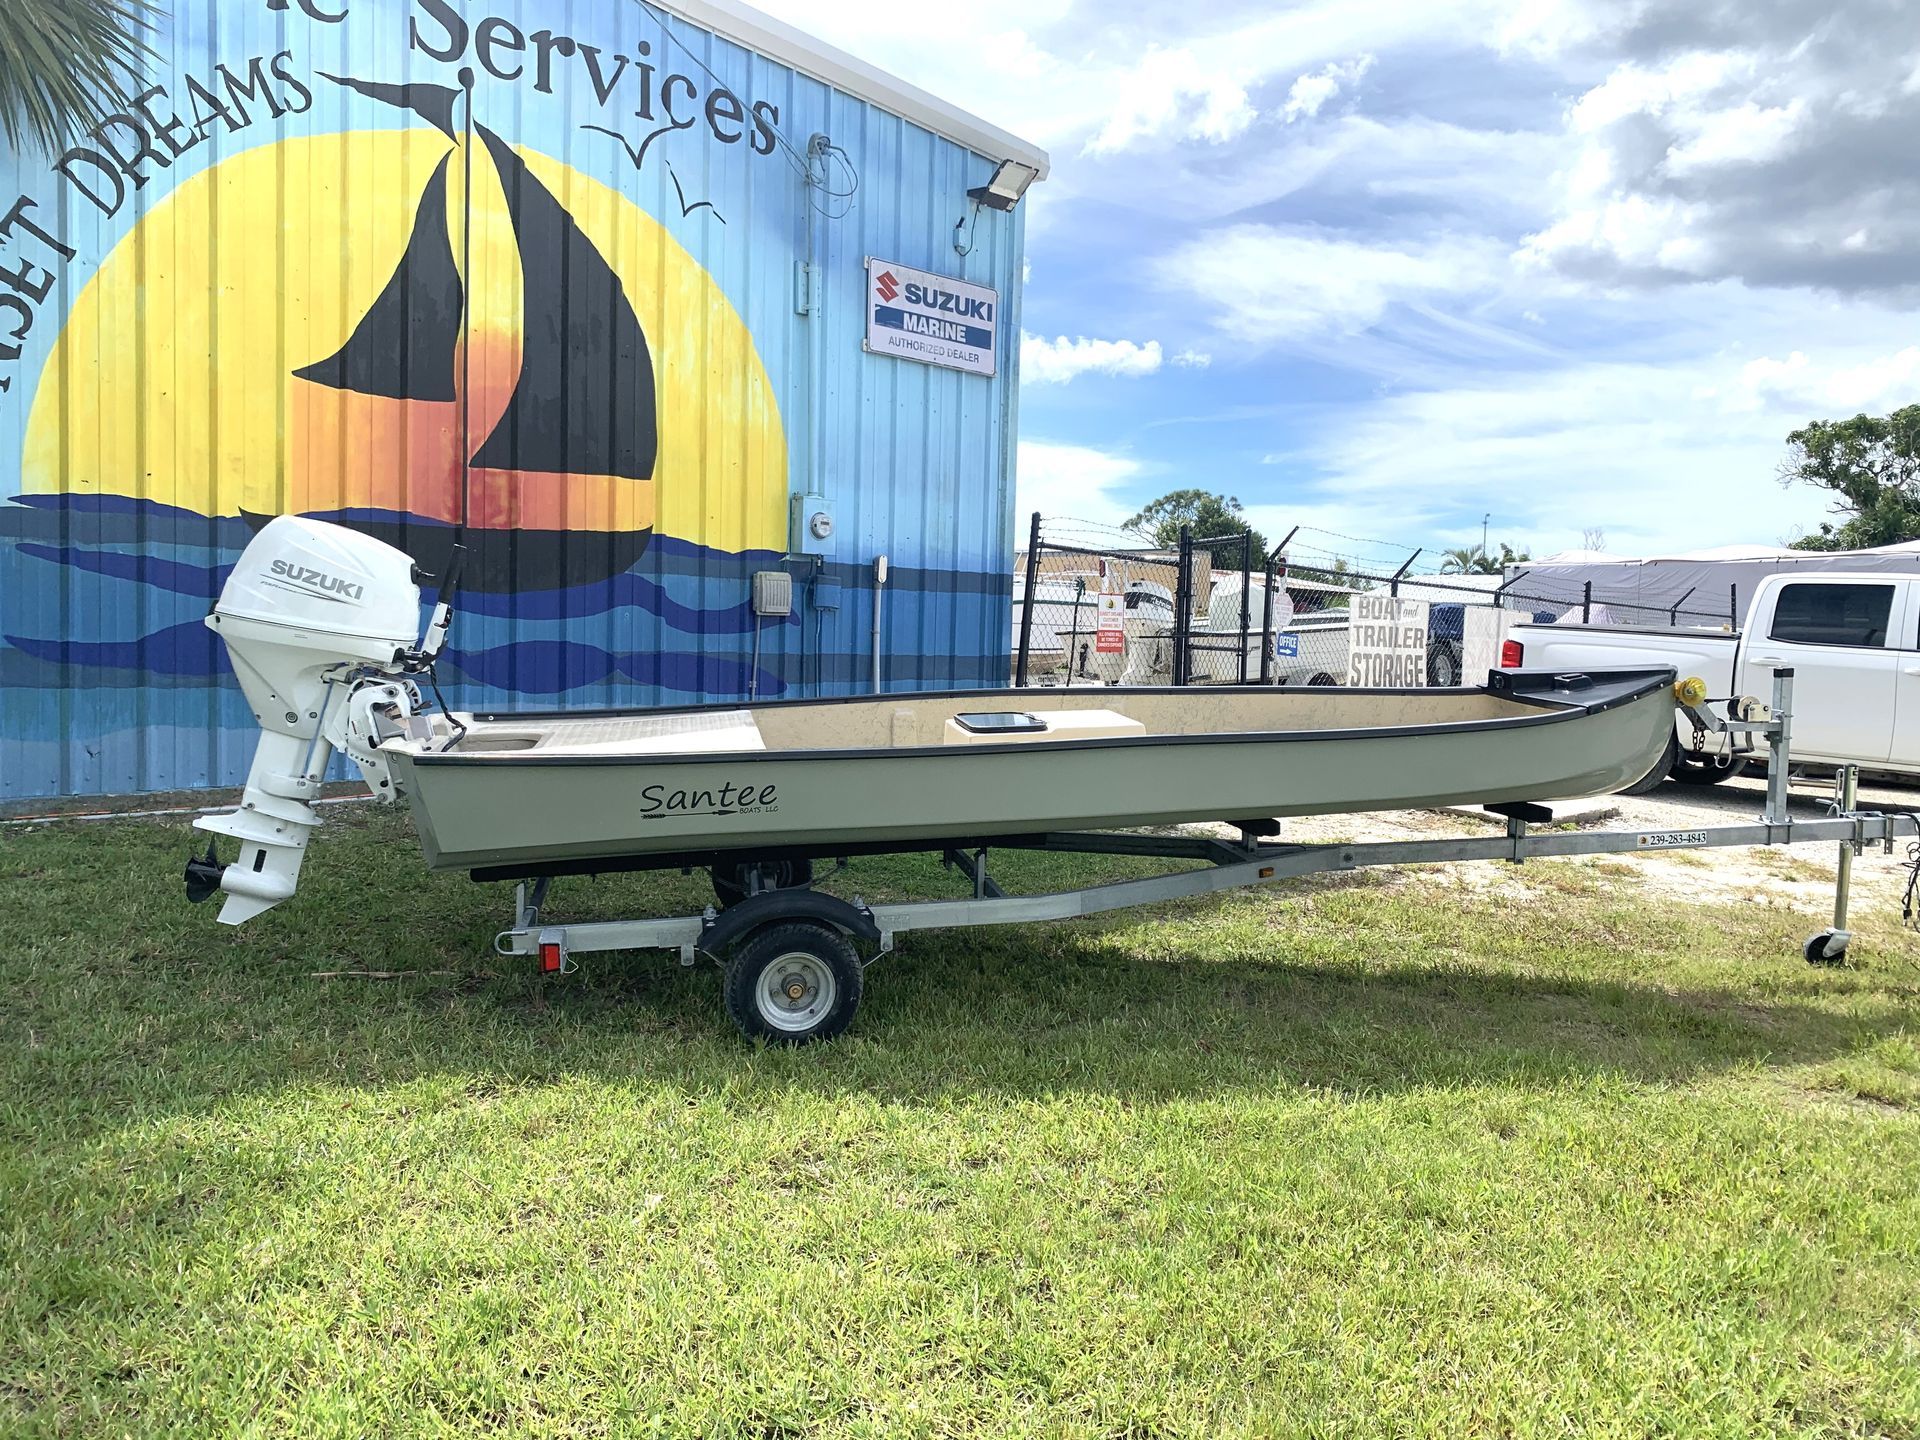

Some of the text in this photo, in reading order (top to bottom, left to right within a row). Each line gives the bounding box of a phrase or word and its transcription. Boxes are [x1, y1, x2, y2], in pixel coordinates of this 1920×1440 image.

[409, 0, 781, 156] Services
[51, 49, 313, 220] DREAMS
[904, 283, 993, 322] SUZUKI
[903, 313, 967, 343] MARINE
[888, 336, 980, 363] AUTHORIZED DEALER
[270, 559, 364, 600] SUZUKI
[1358, 597, 1419, 621] BOAT and
[1279, 635, 1297, 649] OFFICE
[1353, 625, 1425, 649] TRAILER
[1350, 652, 1424, 687] STORAGE
[639, 781, 778, 812] Santee
[739, 805, 779, 814] BOATS LLC
[1650, 833, 1706, 845] 239-283-4843
